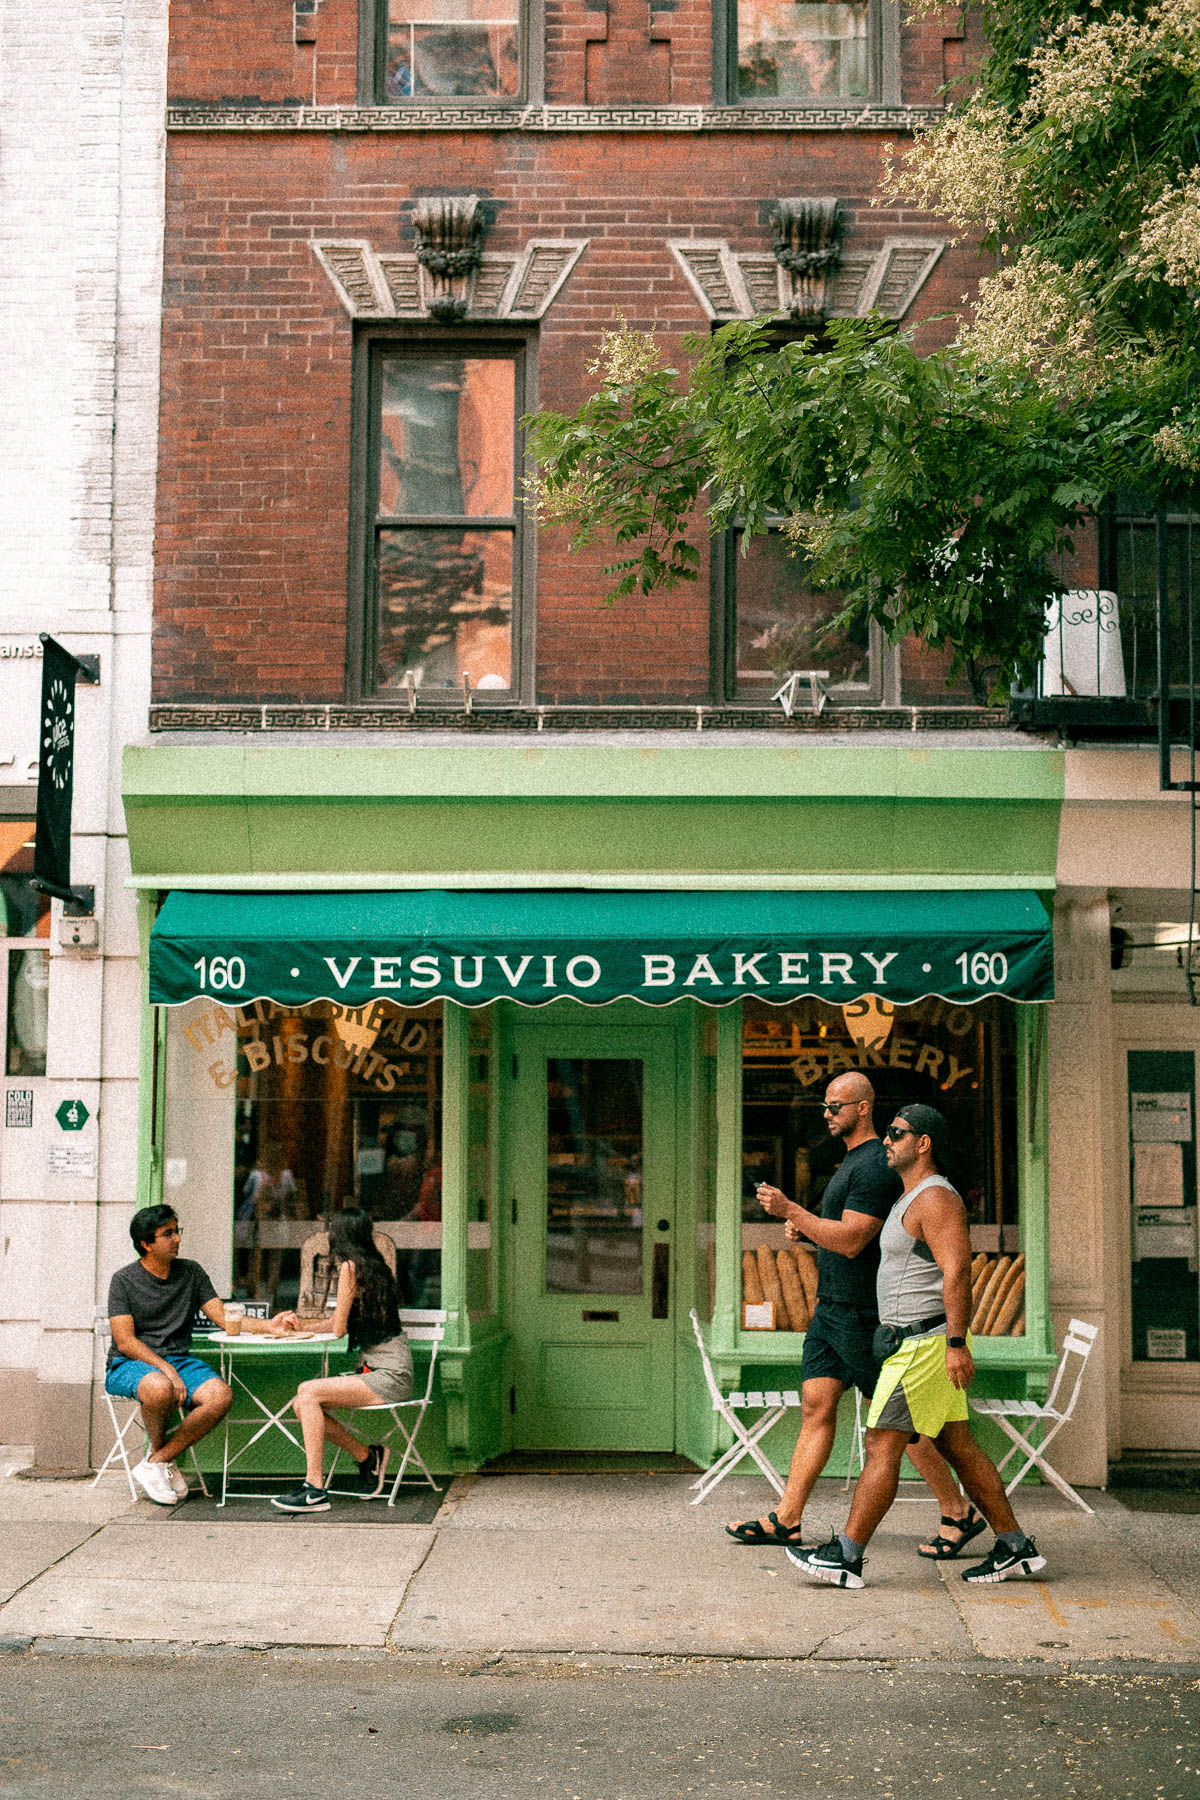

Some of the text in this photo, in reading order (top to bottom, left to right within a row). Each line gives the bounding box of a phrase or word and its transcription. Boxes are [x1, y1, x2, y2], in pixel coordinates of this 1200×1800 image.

[194, 951, 1008, 990] 160 VESUVIO BAKERY 160
[208, 1032, 404, 1092] & BISCUITS
[791, 1036, 975, 1088] BAKERY
